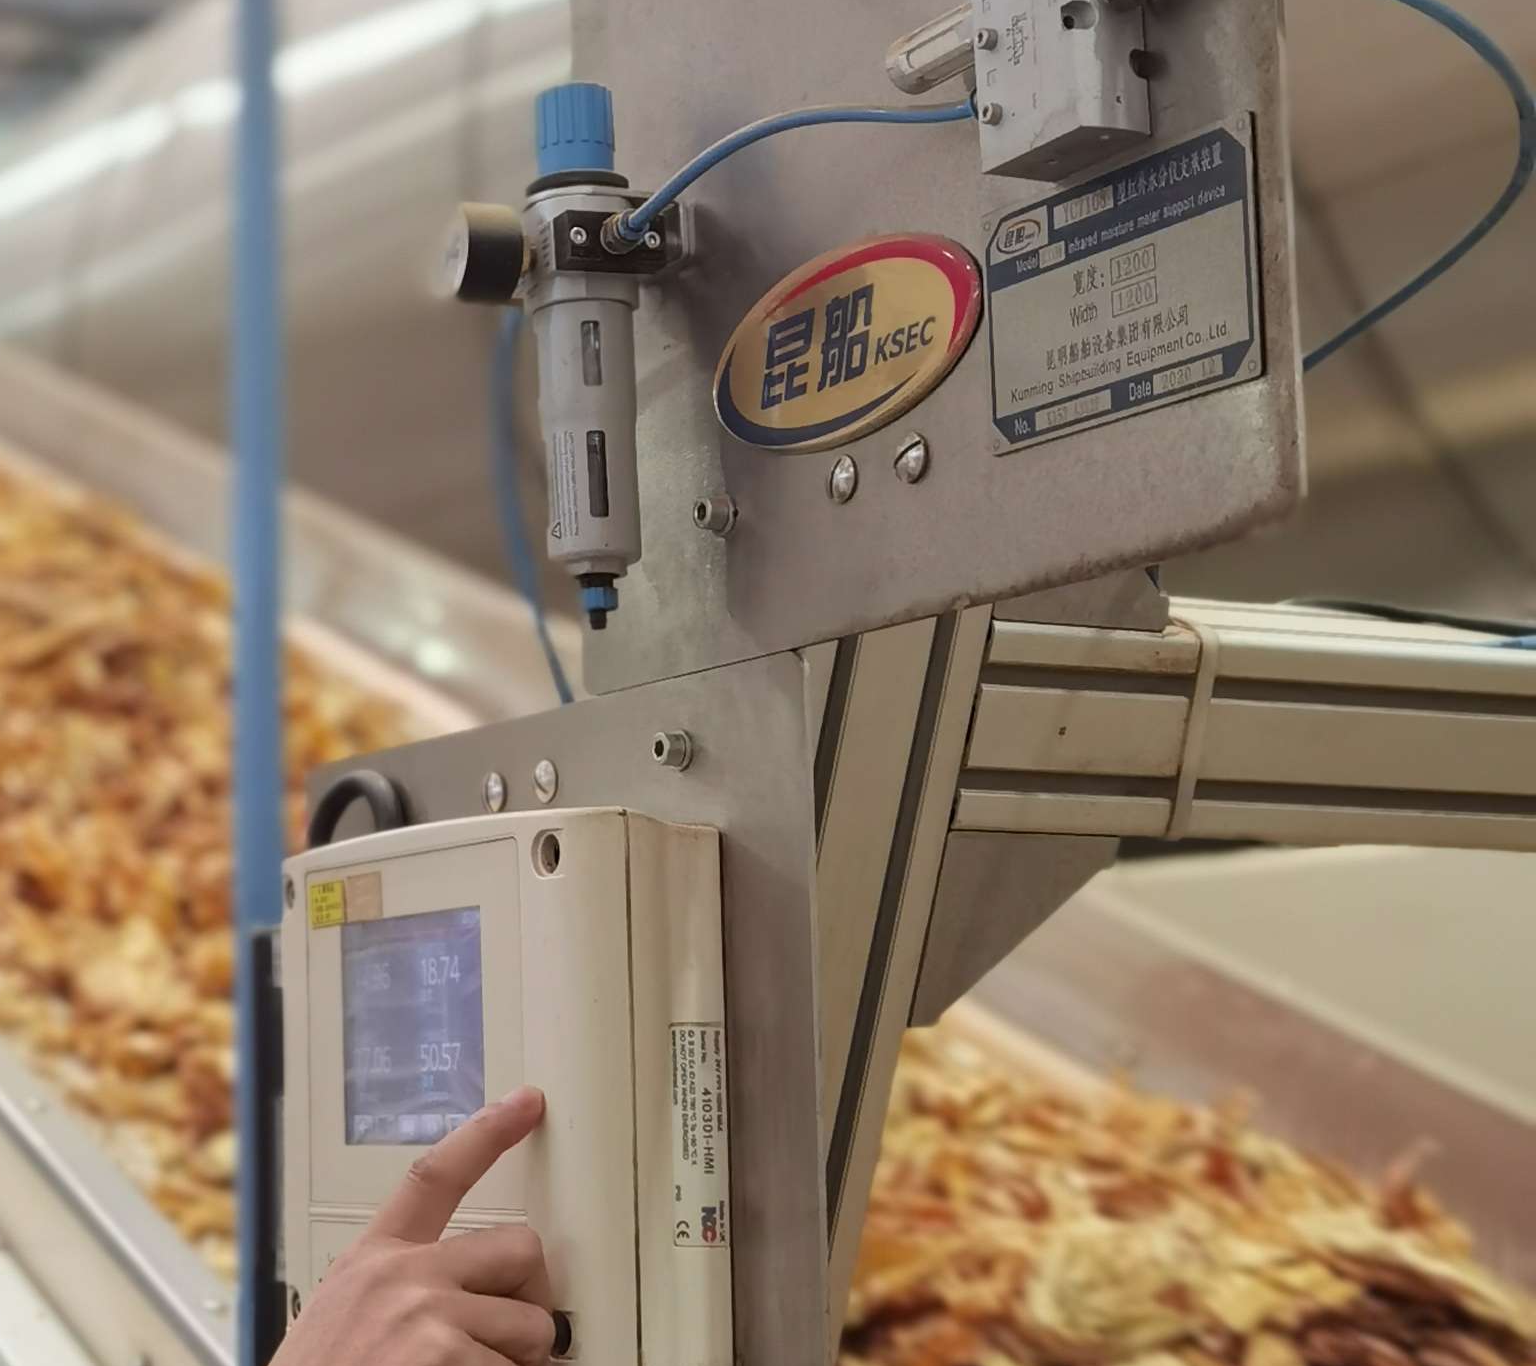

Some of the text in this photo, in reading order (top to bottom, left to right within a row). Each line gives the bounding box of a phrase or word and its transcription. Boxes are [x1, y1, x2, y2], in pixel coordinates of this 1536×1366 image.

[1163, 198, 1195, 219] support
[1197, 185, 1226, 205] device
[1114, 249, 1151, 279] 1200
[1069, 282, 1154, 327] Width 1200
[761, 283, 936, 410] 昆船 KSEC
[1010, 378, 1054, 403] Kunming
[1058, 358, 1121, 389] Shipbuilding
[1126, 338, 1185, 370] Equipment
[1129, 379, 1152, 401] Date
[420, 954, 461, 987] 18.74
[680, 1030, 687, 1042] DO
[419, 1042, 462, 1073] 50.57
[680, 1062, 688, 1085] OPEN
[702, 1087, 715, 1175] 410301-HMI
[701, 1206, 717, 1243] NDC
